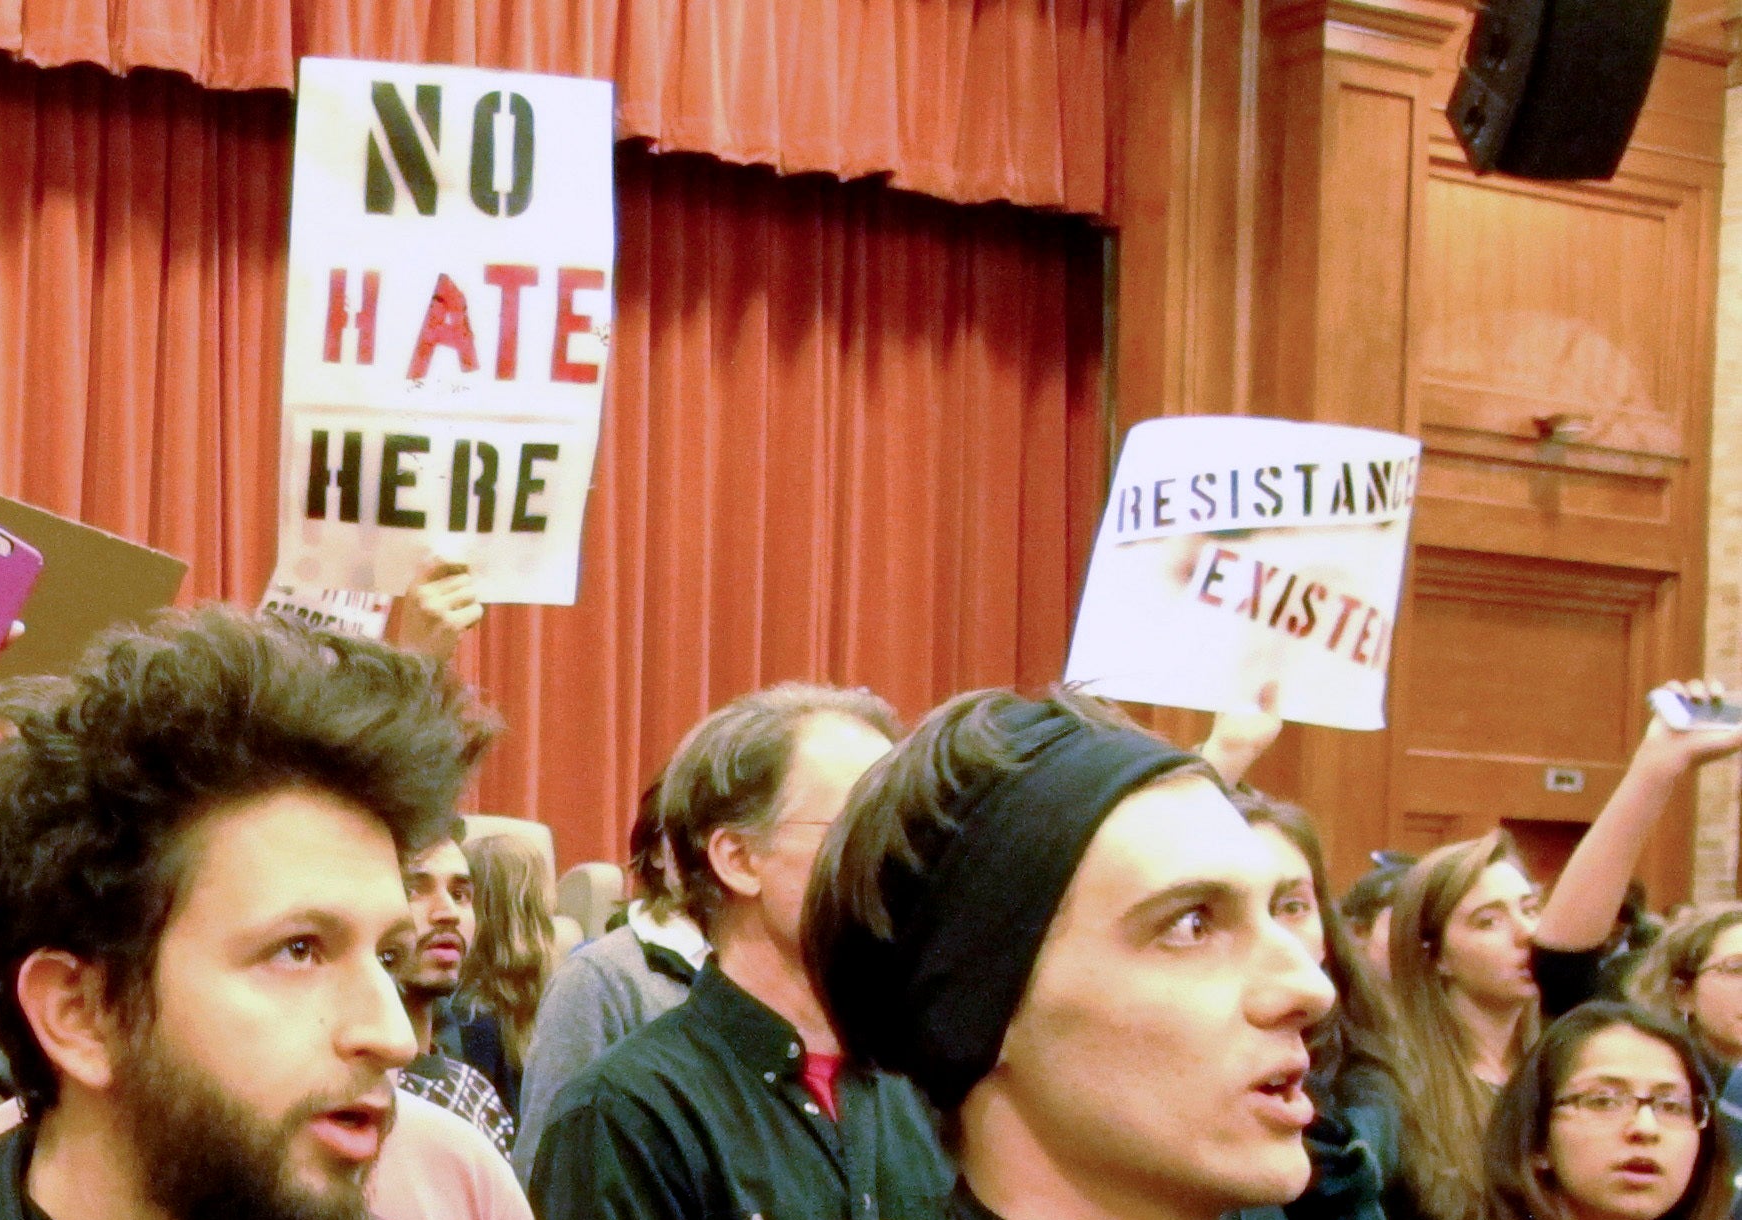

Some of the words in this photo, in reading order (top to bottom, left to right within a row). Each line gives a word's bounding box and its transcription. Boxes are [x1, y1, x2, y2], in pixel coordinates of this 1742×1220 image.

[364, 80, 535, 218] NO
[323, 264, 606, 384] HATE
[306, 428, 560, 534] HERE
